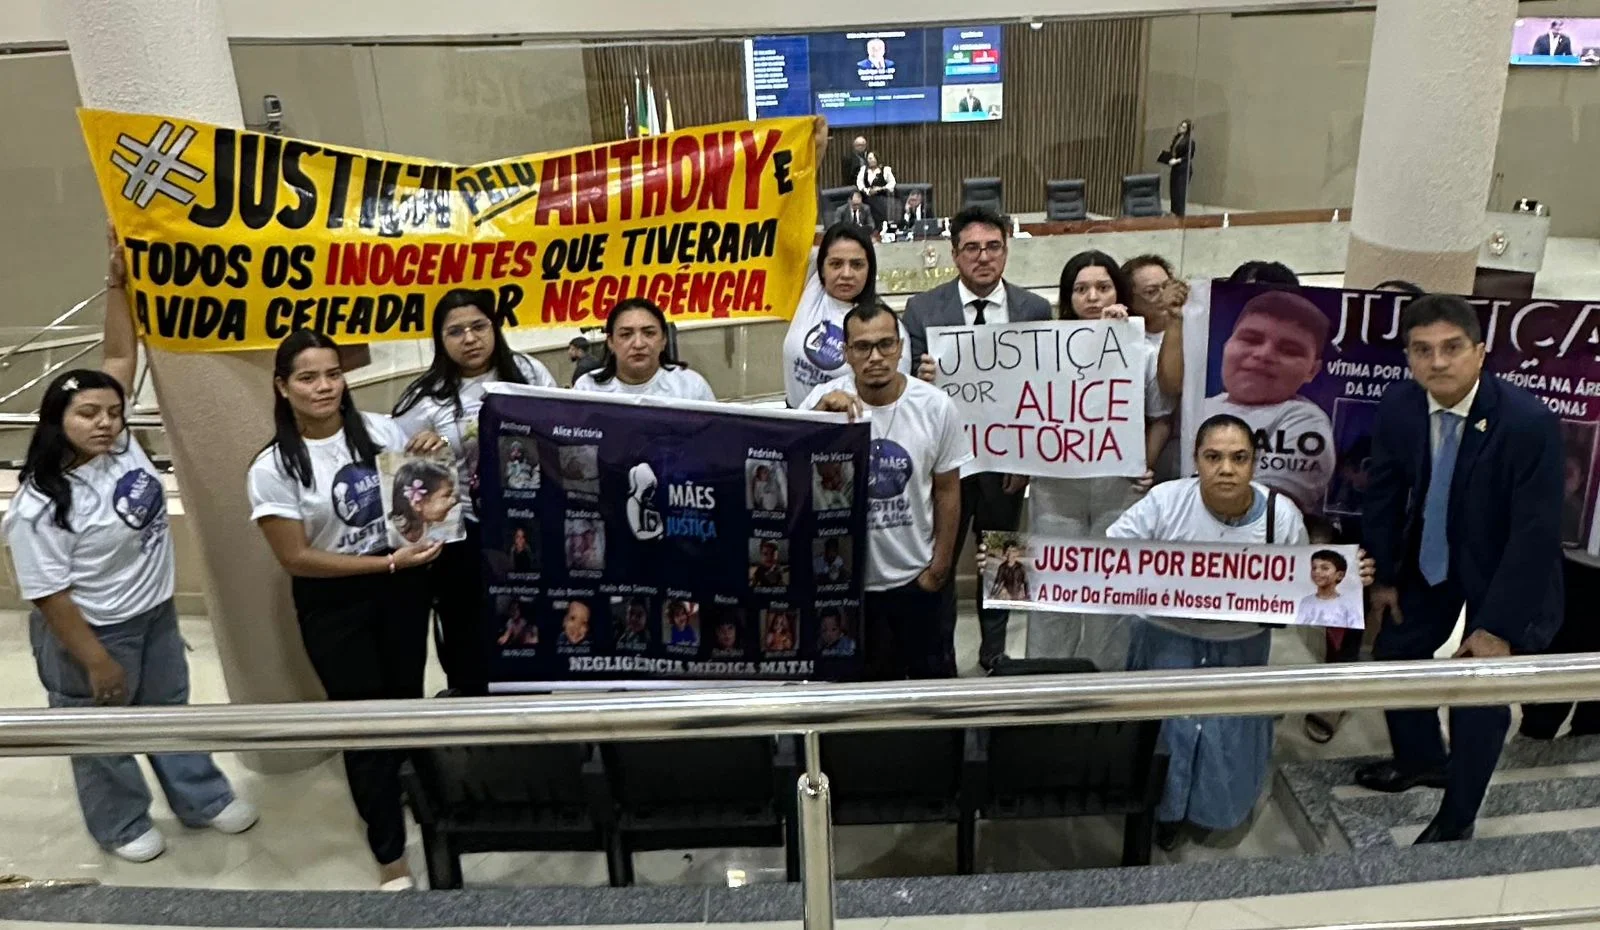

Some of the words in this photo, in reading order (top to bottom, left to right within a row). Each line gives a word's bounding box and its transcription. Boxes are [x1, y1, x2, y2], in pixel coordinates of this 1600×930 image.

[534, 129, 783, 226] ANTHONY
[773, 149, 793, 195] E
[124, 237, 252, 288] TODOS
[262, 245, 316, 290] OS
[325, 241, 536, 286] INOCENTES
[542, 233, 609, 280] QUE
[622, 218, 778, 267] TIVERAM
[155, 295, 247, 341] VIDA
[265, 293, 425, 338] CEIFADA
[938, 326, 1128, 380] JUSTIÇA
[1327, 359, 1370, 377] VÍTIMA
[1373, 364, 1402, 380] POR
[1495, 370, 1546, 389] ÉDICA
[1550, 377, 1571, 394] NA
[1345, 381, 1364, 395] DA
[941, 381, 996, 403] POR
[1015, 379, 1132, 423] ALICE
[552, 425, 571, 437] Alice
[573, 427, 603, 439] Victória
[964, 423, 1123, 463] ICTÓRIA
[1253, 428, 1325, 456] ALO
[1260, 456, 1321, 473] SOUZA
[668, 480, 716, 510] MÃES
[667, 516, 718, 541] JUSTIÇA
[1035, 545, 1131, 580] JUSTIÇA
[1138, 549, 1185, 576] POR
[1191, 547, 1296, 582] BENÍCIO!
[1038, 583, 1048, 602] A
[1053, 584, 1077, 602] Dor
[1081, 586, 1100, 603] Da
[1104, 586, 1157, 606] Família
[1161, 589, 1170, 606] é
[1174, 589, 1222, 609] Nossa
[1226, 592, 1294, 614] Também
[569, 654, 685, 674] NEGLIGÊNCIA
[688, 659, 756, 673] MÉDICA
[760, 660, 814, 673] MATA!
